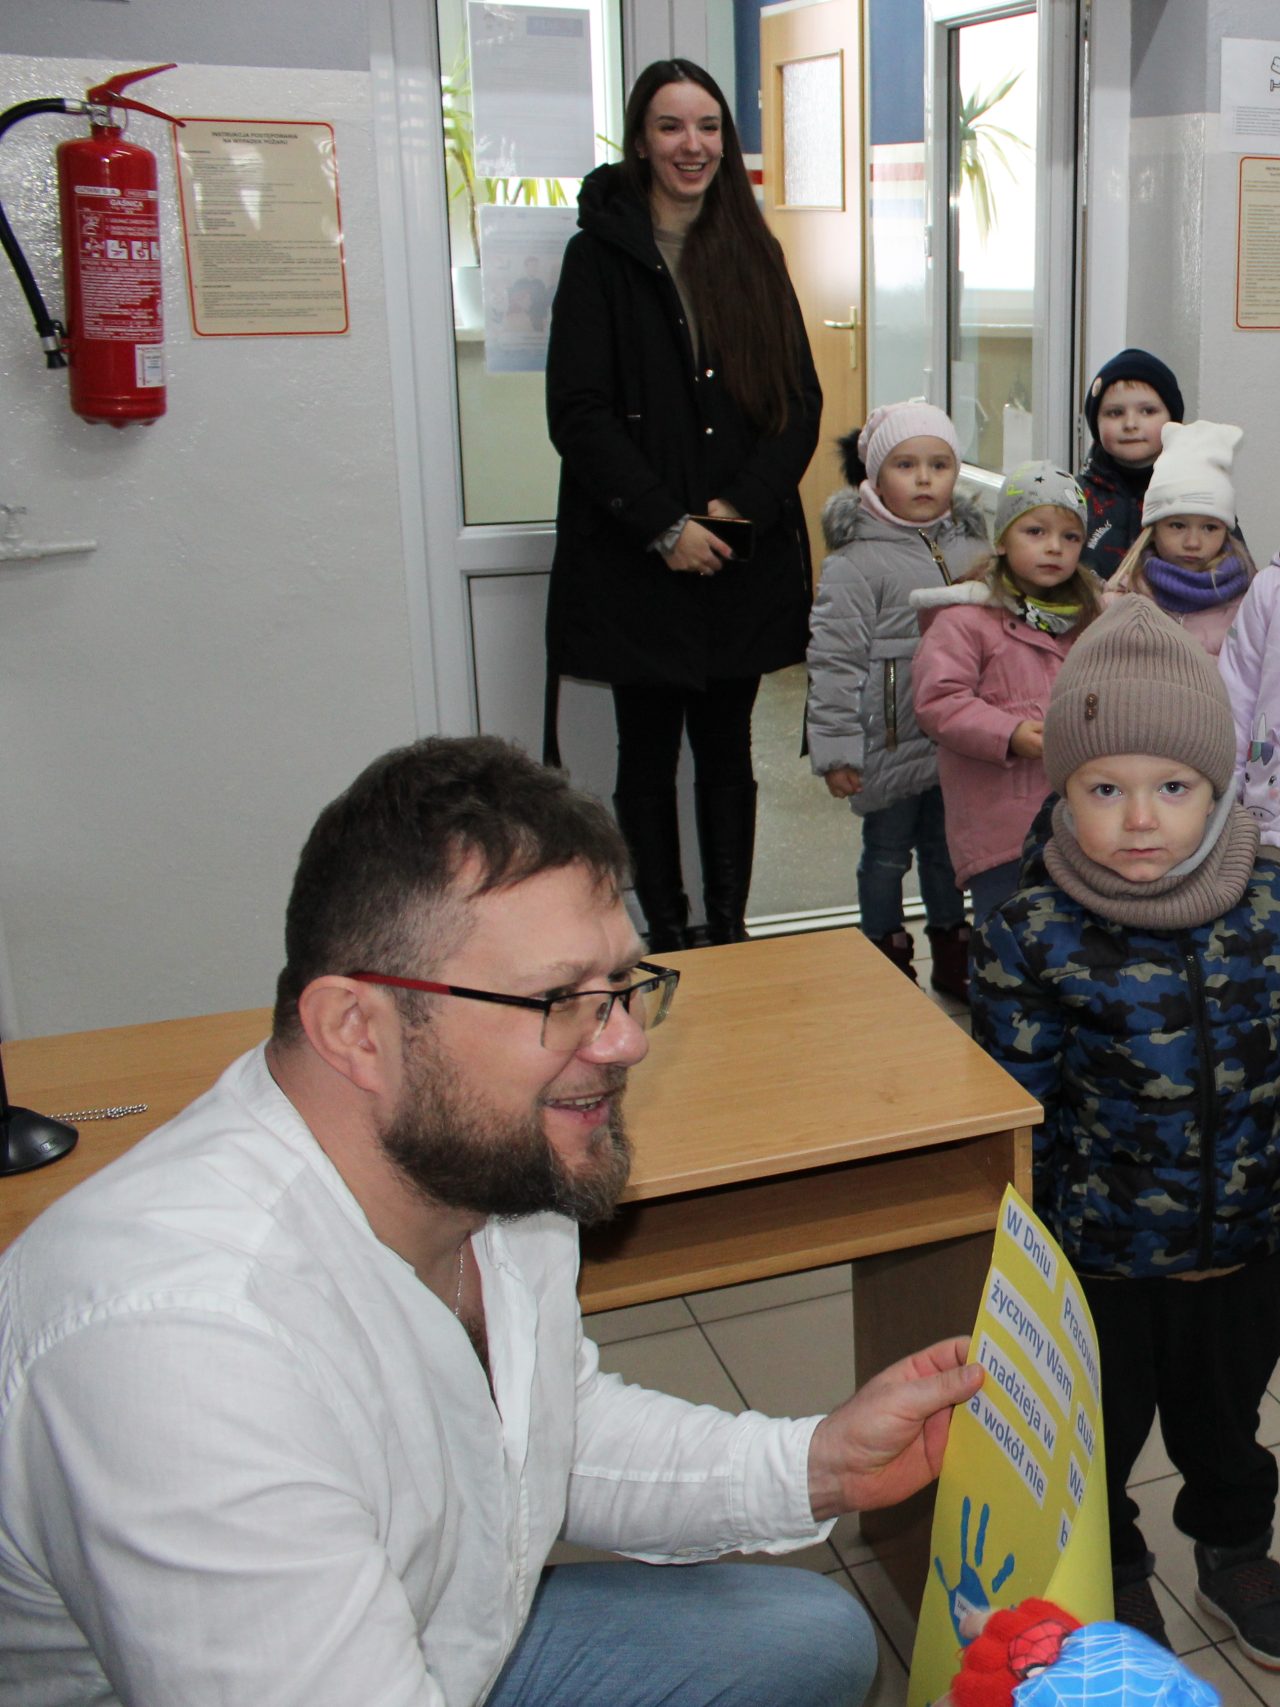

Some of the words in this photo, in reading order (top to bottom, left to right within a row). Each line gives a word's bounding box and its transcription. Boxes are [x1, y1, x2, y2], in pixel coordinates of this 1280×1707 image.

[1007, 1204, 1022, 1237] W
[1023, 1225, 1051, 1278] Dniu
[991, 1279, 1045, 1359] życzymy
[1046, 1341, 1073, 1401] Wam
[970, 1395, 981, 1415] a
[984, 1406, 1025, 1467] wokół
[1025, 1459, 1044, 1498] nie
[979, 1342, 987, 1364] i
[988, 1354, 1041, 1431] nadzieja
[1043, 1423, 1054, 1449] w
